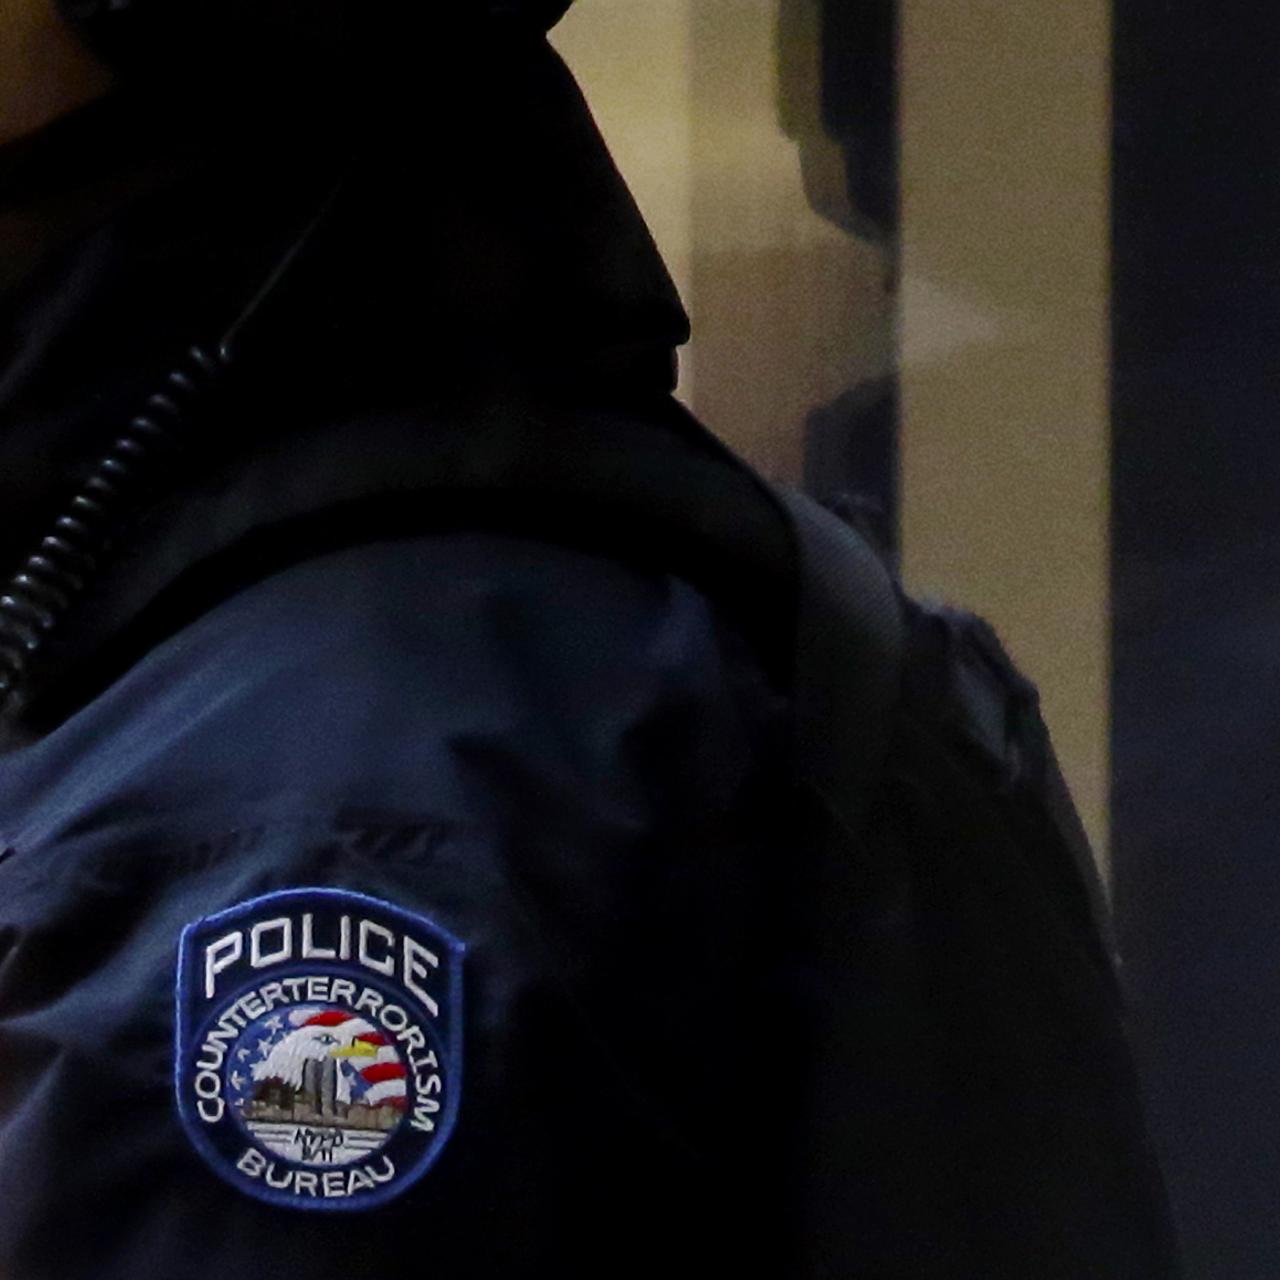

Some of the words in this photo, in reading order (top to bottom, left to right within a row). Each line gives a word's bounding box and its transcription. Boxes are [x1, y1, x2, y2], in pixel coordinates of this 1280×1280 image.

[205, 913, 439, 1018] POLICE
[194, 976, 441, 1132] COUNTERTERRORISM
[236, 1146, 396, 1198] BUREAU
